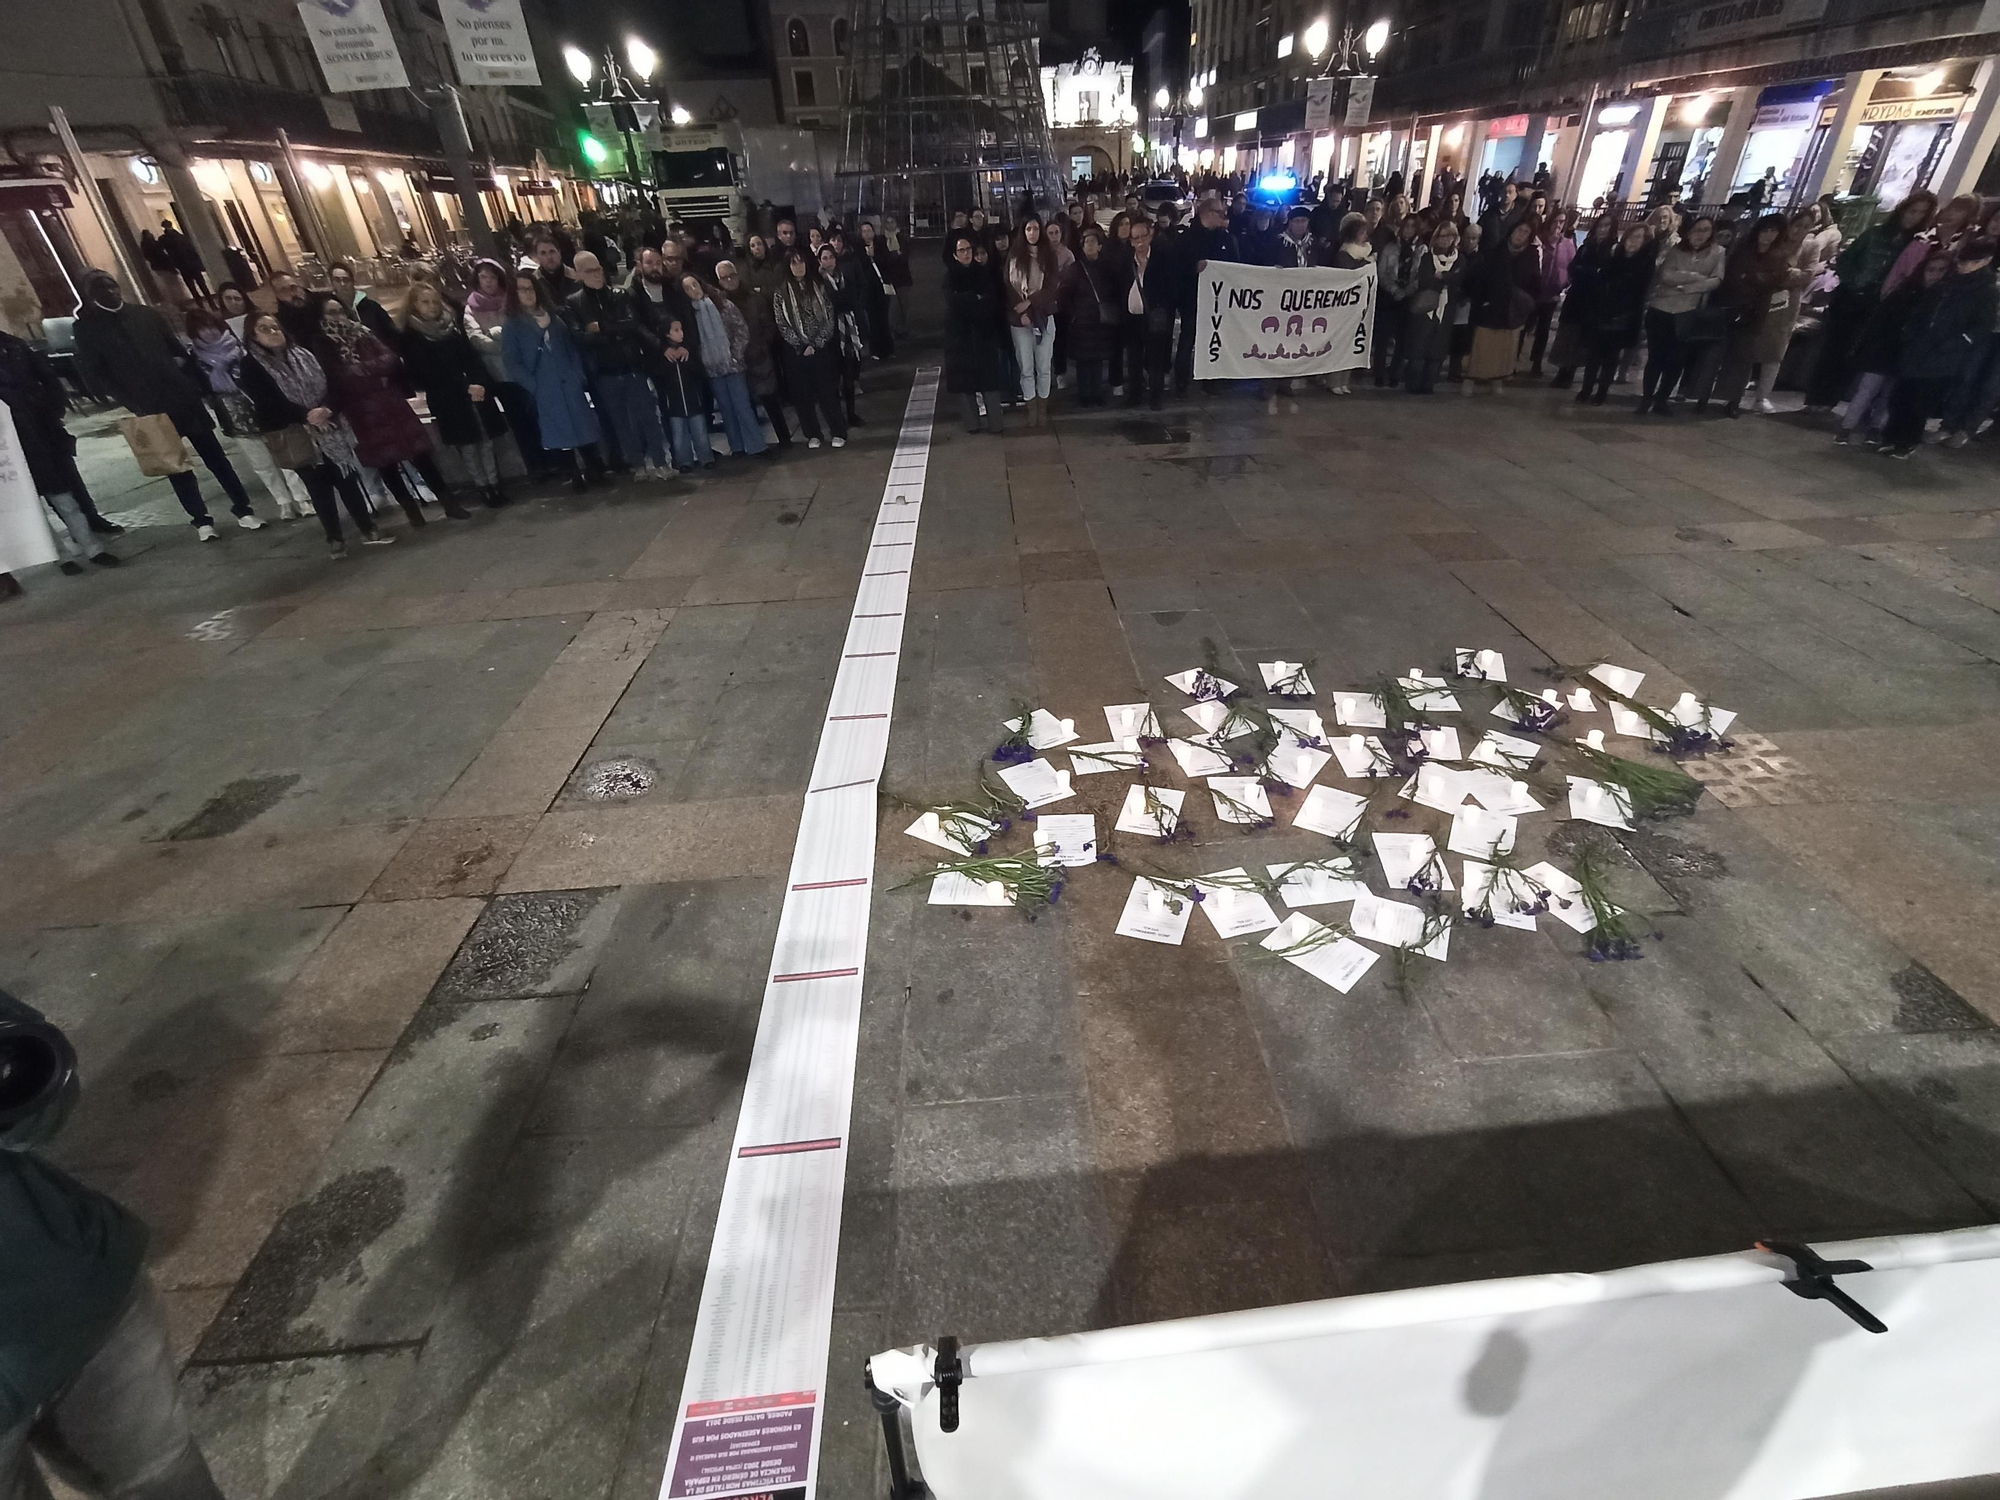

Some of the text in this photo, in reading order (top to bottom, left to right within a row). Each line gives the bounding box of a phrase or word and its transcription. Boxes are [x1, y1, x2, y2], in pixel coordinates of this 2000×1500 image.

[456, 18, 512, 31] No pienses
[319, 28, 332, 37] No
[470, 37, 488, 48] por
[490, 54, 512, 62] eres
[514, 53, 527, 65] yo
[1229, 285, 1362, 312] NOS QUEREMOS
[722, 1415, 743, 1425] DESDE
[744, 1413, 765, 1422] DATOS
[720, 1428, 761, 1440] ASESINADOS
[761, 1425, 792, 1435] MENORES
[692, 1436, 704, 1444] SUS
[706, 1434, 719, 1442] POR
[761, 1458, 782, 1468] DESDE
[685, 1465, 796, 1488] VIOLENCIA DE GÉNERO EN ESPAÑA
[685, 1488, 694, 1496] LA
[696, 1486, 705, 1494] DE
[705, 1482, 741, 1492] MORTALES
